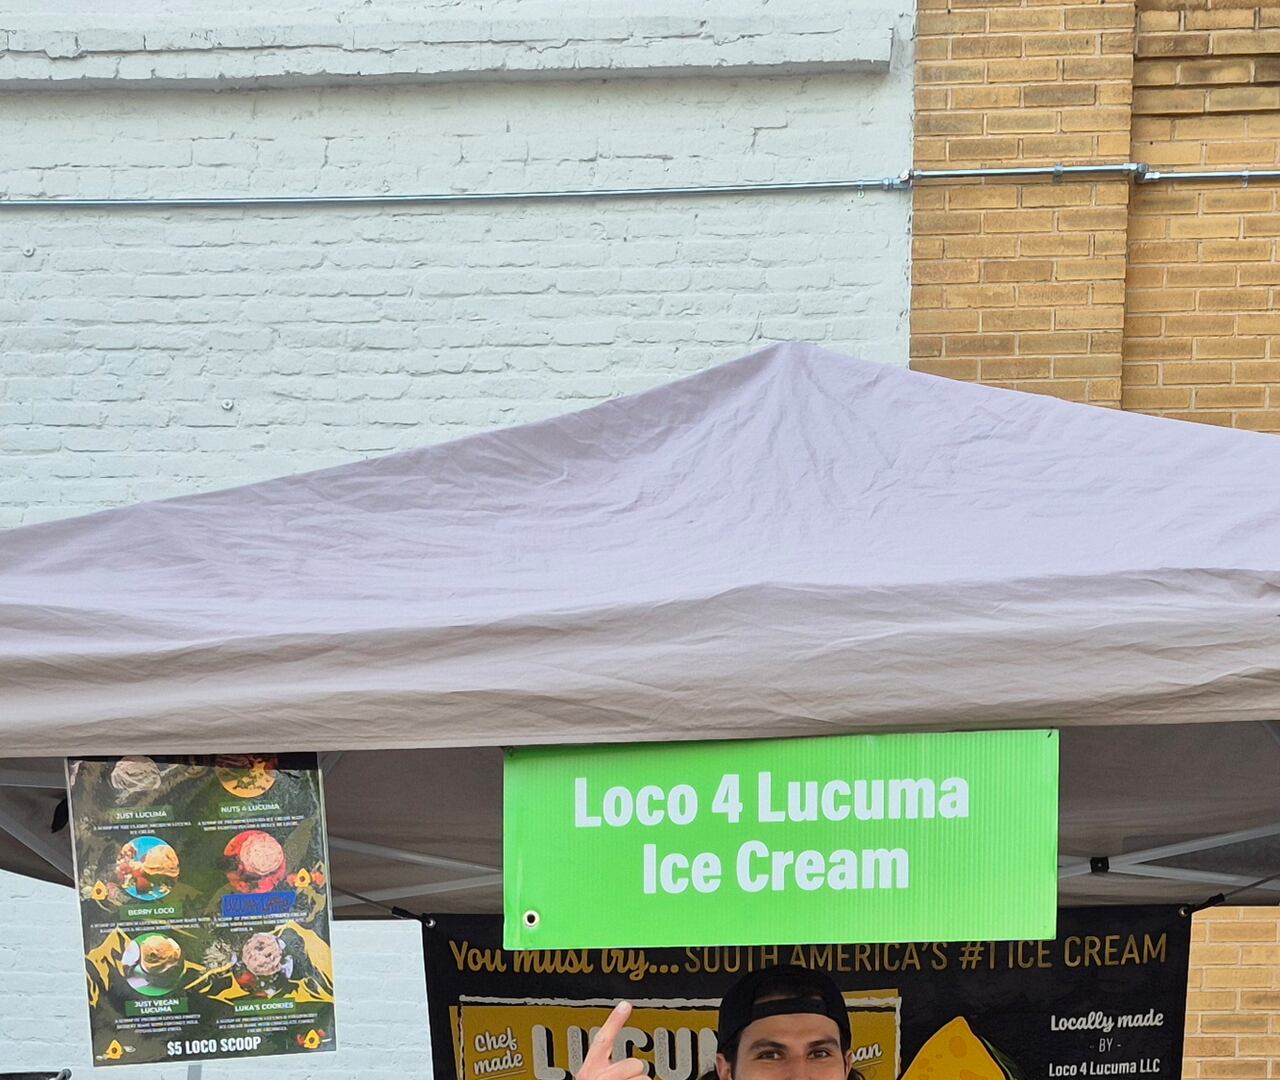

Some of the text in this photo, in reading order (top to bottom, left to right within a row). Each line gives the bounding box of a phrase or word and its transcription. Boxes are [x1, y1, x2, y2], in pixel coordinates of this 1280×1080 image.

[574, 771, 969, 828] Loco 4 Lucuma
[642, 838, 909, 894] Ice Cream
[449, 940, 507, 972] You
[684, 946, 778, 973] SOUTH
[790, 942, 947, 972] AMERICA'S
[960, 941, 995, 970] #1
[1008, 940, 1052, 969] ICE
[1064, 933, 1166, 968] CREAM
[1051, 1008, 1164, 1032] Locally made
[167, 1036, 261, 1056] $5 LOCO SCOOP
[474, 1028, 518, 1053] Chef
[473, 1052, 523, 1075] made
[1049, 1058, 1160, 1077] Loco 4 Lucuma LLC
